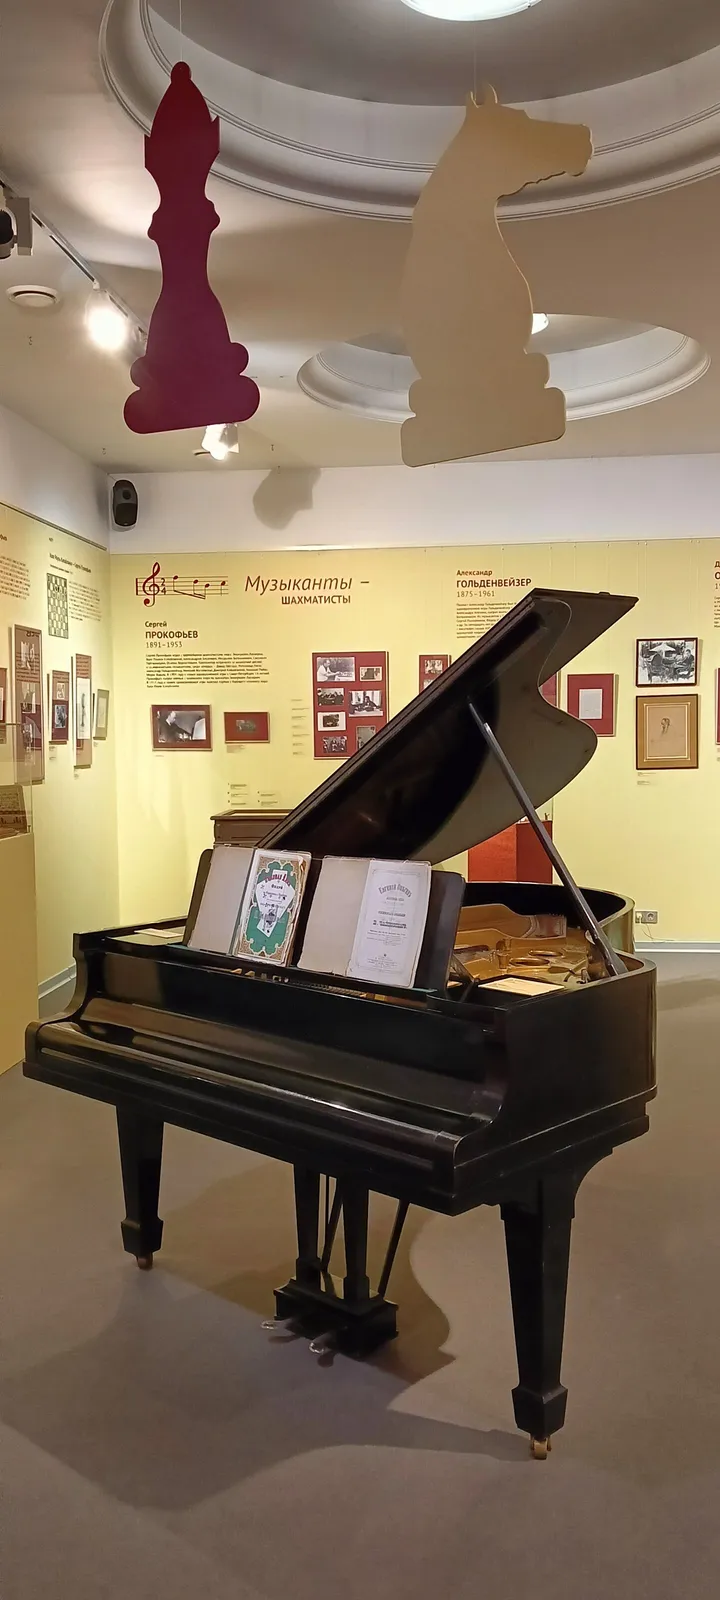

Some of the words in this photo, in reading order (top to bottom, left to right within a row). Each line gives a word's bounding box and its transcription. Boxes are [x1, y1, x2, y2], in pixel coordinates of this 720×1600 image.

[244, 575, 353, 595] Музыканты
[456, 577, 532, 589] ГОЛЬДЕНВЕЙЗЕР
[281, 595, 351, 605] ШАХМАТИСТЫ
[144, 620, 168, 629] Сергей
[145, 630, 199, 640] ПРОКОФЬЕВ
